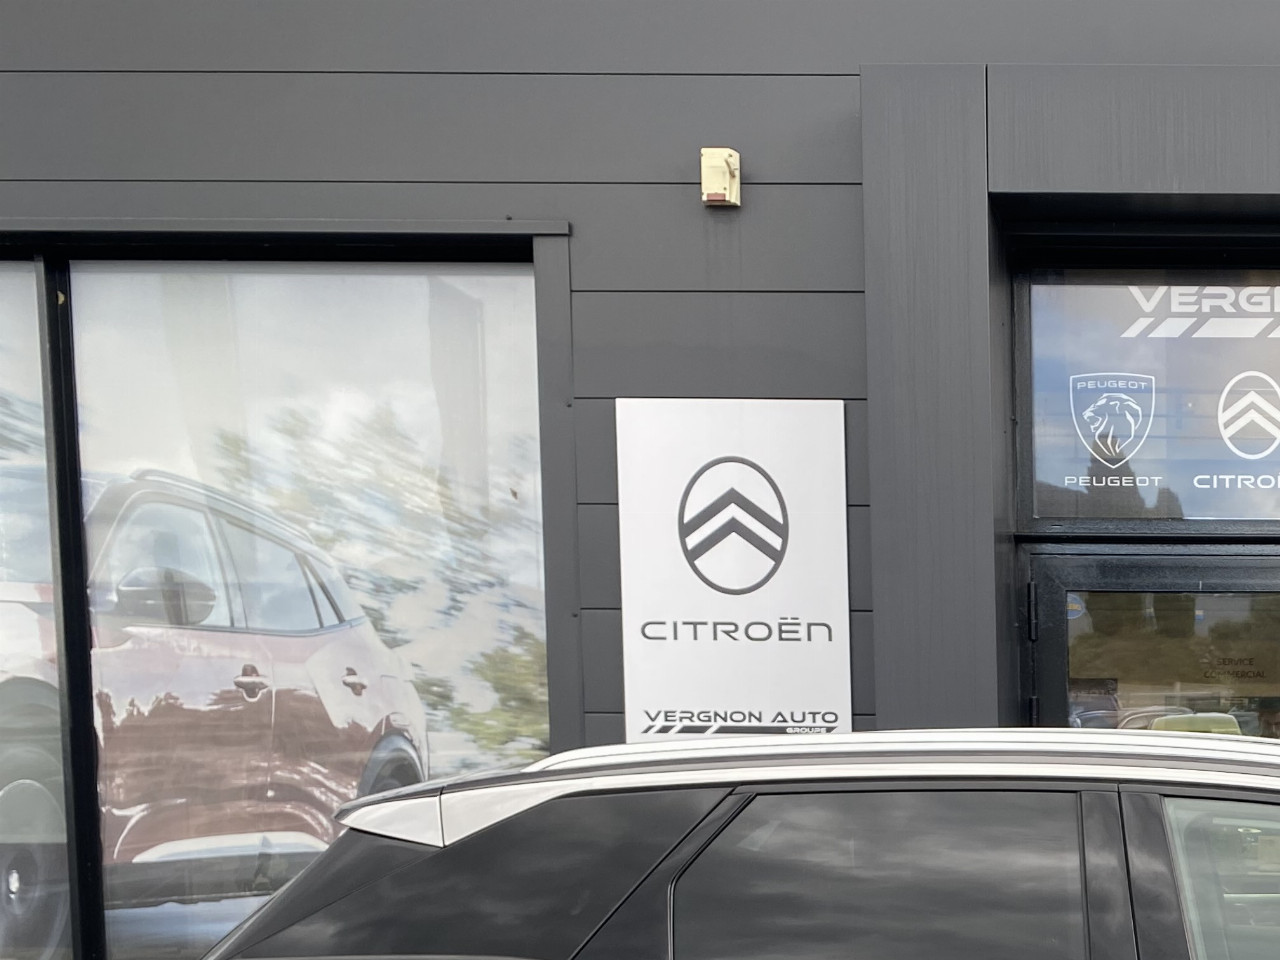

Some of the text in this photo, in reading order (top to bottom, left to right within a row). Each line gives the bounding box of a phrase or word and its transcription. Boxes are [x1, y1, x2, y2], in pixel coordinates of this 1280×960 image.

[1076, 379, 1148, 391] PEUGEOT
[1064, 475, 1163, 487] PEUGEOT
[640, 617, 834, 643] CITROËN
[643, 710, 840, 724] VERGNON AUTO
